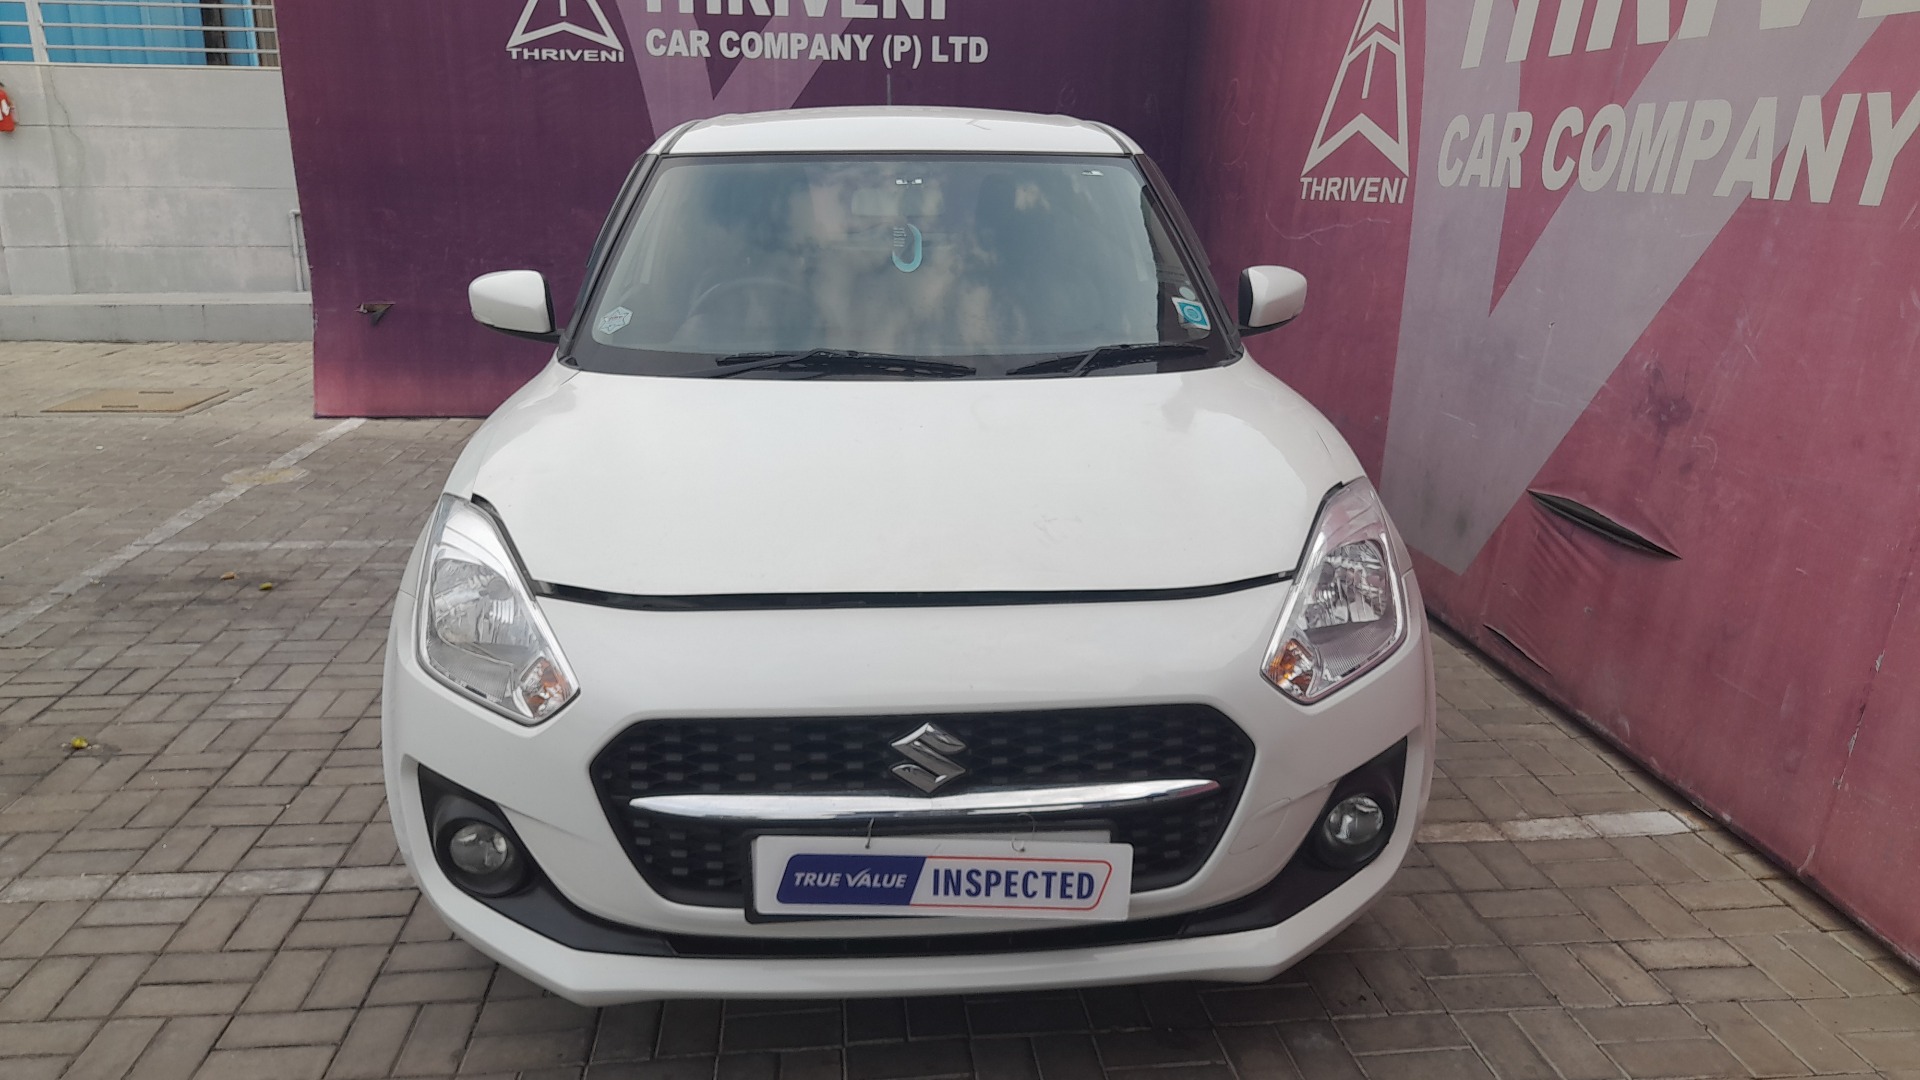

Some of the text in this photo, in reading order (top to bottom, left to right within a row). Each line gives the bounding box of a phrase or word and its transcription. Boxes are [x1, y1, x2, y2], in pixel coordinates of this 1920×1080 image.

[509, 47, 624, 62] THRIVENI
[645, 28, 988, 69] CAR COMPANY (P) LTD
[1437, 91, 1920, 206] CAR COMPANY
[1300, 177, 1408, 204] THRIVENI
[794, 868, 1095, 900] TRUE VALUE INSPECTED
